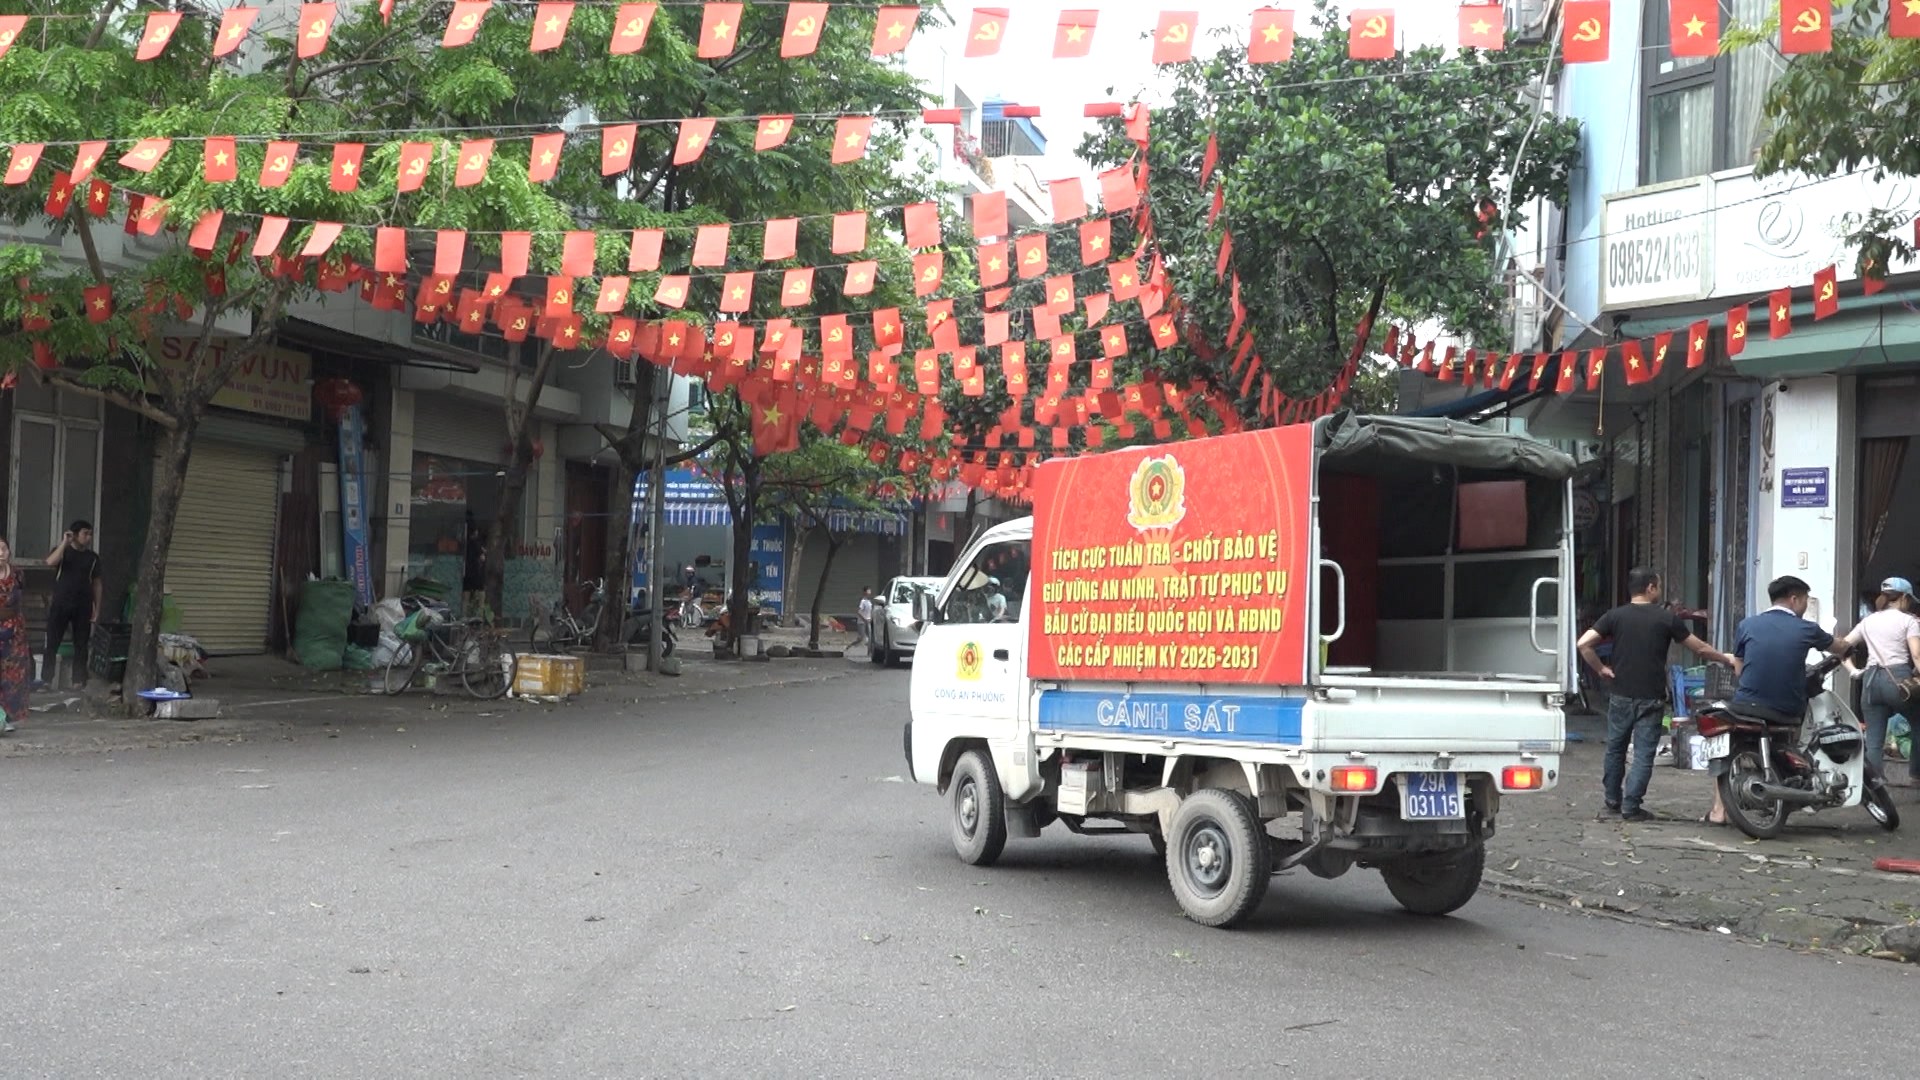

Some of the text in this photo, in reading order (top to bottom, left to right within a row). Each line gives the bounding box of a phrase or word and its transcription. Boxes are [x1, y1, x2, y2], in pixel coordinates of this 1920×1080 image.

[1625, 209, 1682, 231] Hotline
[1609, 230, 1700, 288] 0985224633
[1052, 547, 1079, 570] TÍCH
[1081, 547, 1106, 572] CỰC
[1146, 543, 1171, 565] TRA
[1183, 531, 1221, 563] CHỐT
[1223, 530, 1254, 561] BẢO
[1259, 529, 1278, 562] VỆ
[1042, 570, 1287, 603] GIỮ VỮNG AN NINH, TRẬT TỰ PHỤC VỤ
[1071, 607, 1089, 634] CỬ
[1089, 612, 1111, 638] ĐẠI
[1147, 603, 1184, 635] QUỐC
[1187, 606, 1212, 637] HỘI
[1215, 605, 1235, 633] VÀ
[1238, 608, 1282, 633] HĐND
[1058, 641, 1082, 667] CÁC
[1084, 638, 1111, 667] CẤP
[1112, 641, 1157, 673] NHIỆM
[1180, 645, 1259, 669] 2026-2031
[958, 689, 969, 700] AN
[1097, 693, 1241, 733] CẢNH SÁT
[1419, 772, 1447, 793] 29A
[1408, 795, 1459, 817] 031.15
